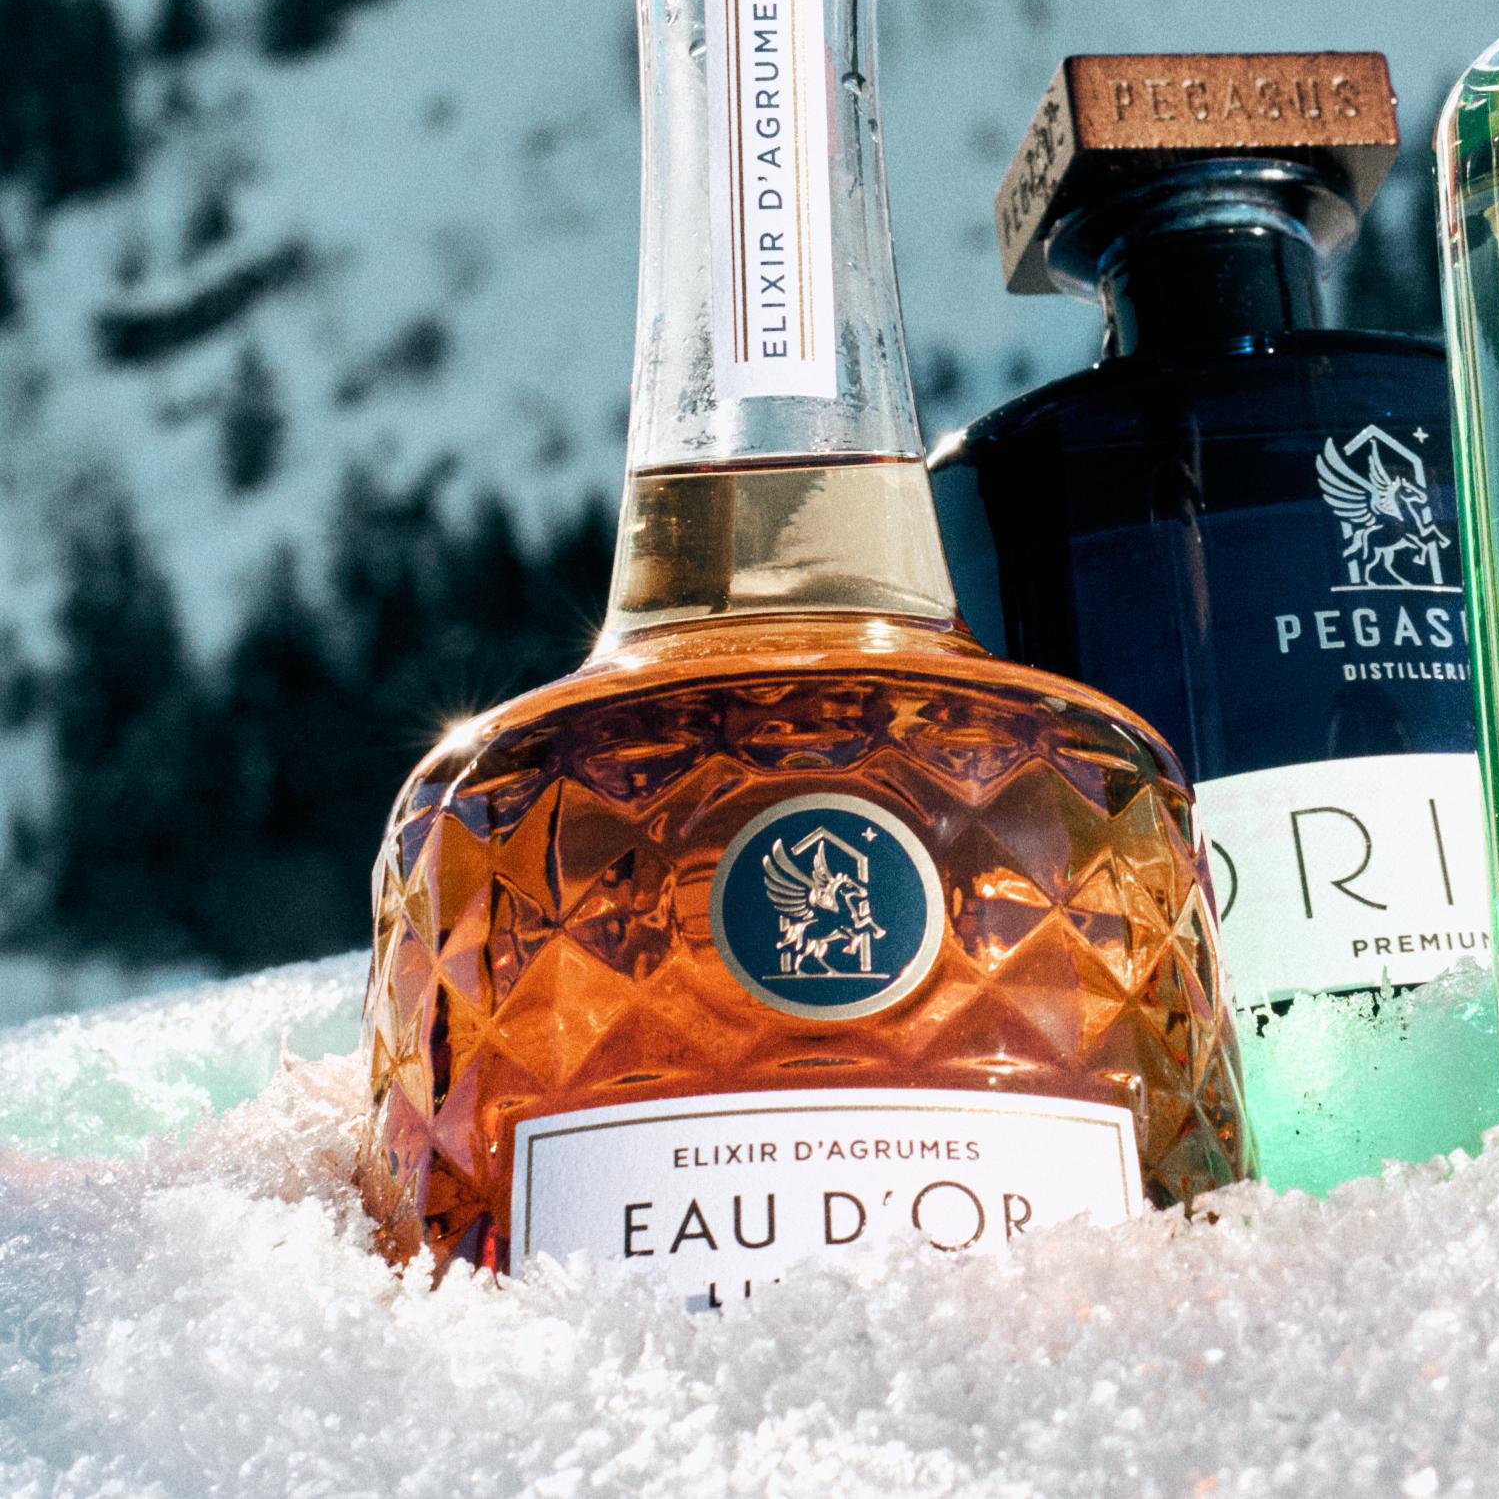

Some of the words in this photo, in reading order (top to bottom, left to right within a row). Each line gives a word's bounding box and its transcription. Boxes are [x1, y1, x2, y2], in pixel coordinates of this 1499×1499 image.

[1110, 75, 1361, 122] PEGASUS
[760, 232, 787, 358] ELIXIR
[1343, 662, 1471, 681] DISTILLERI
[672, 1144, 778, 1168] ELIXIR
[794, 1139, 981, 1161] D'AGRUMES
[624, 1193, 777, 1259] EAU
[823, 1180, 1032, 1253] D'OR
